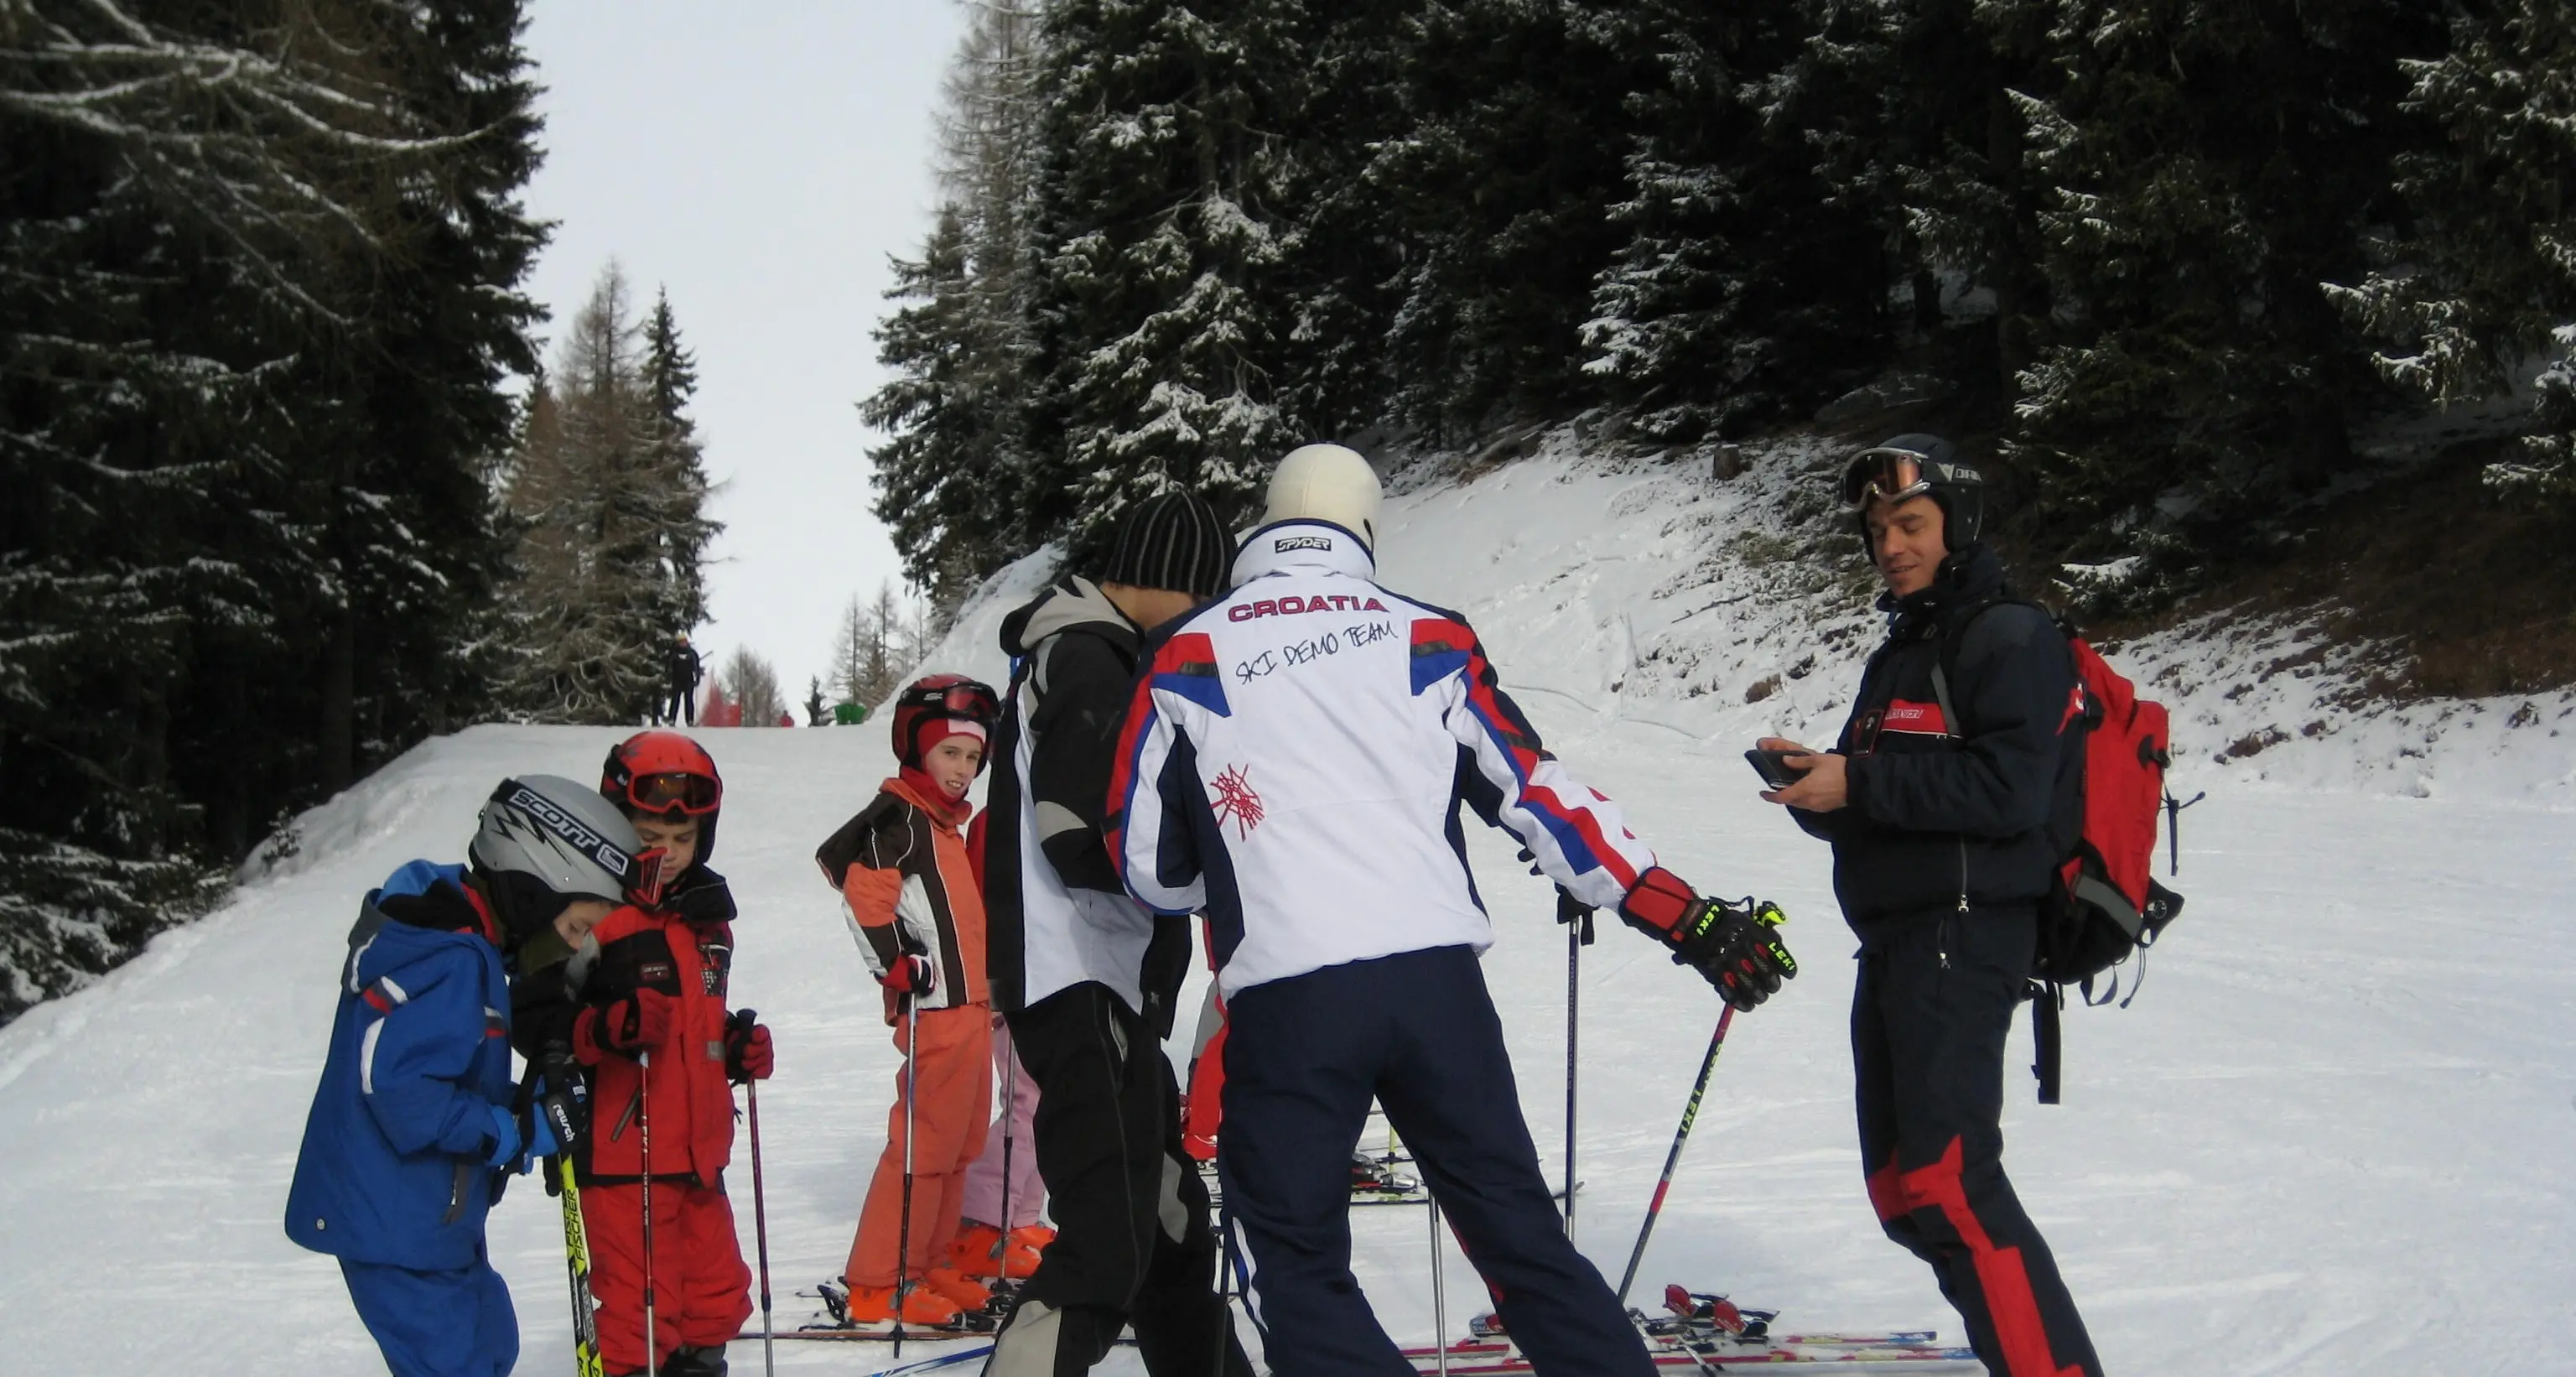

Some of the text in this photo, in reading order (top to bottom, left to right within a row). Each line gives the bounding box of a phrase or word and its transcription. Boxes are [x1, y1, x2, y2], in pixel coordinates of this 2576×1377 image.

[1275, 537, 1332, 552] SPYDER
[1228, 595, 1391, 622] CROATIA
[1235, 620, 1398, 685] SKI DEMO TEAM
[509, 788, 601, 849] SCOTT
[1696, 905, 1720, 936] LEKI
[1768, 942, 1795, 971] LEKI
[553, 1104, 575, 1142] reusch
[567, 1188, 585, 1261] FISCHER
